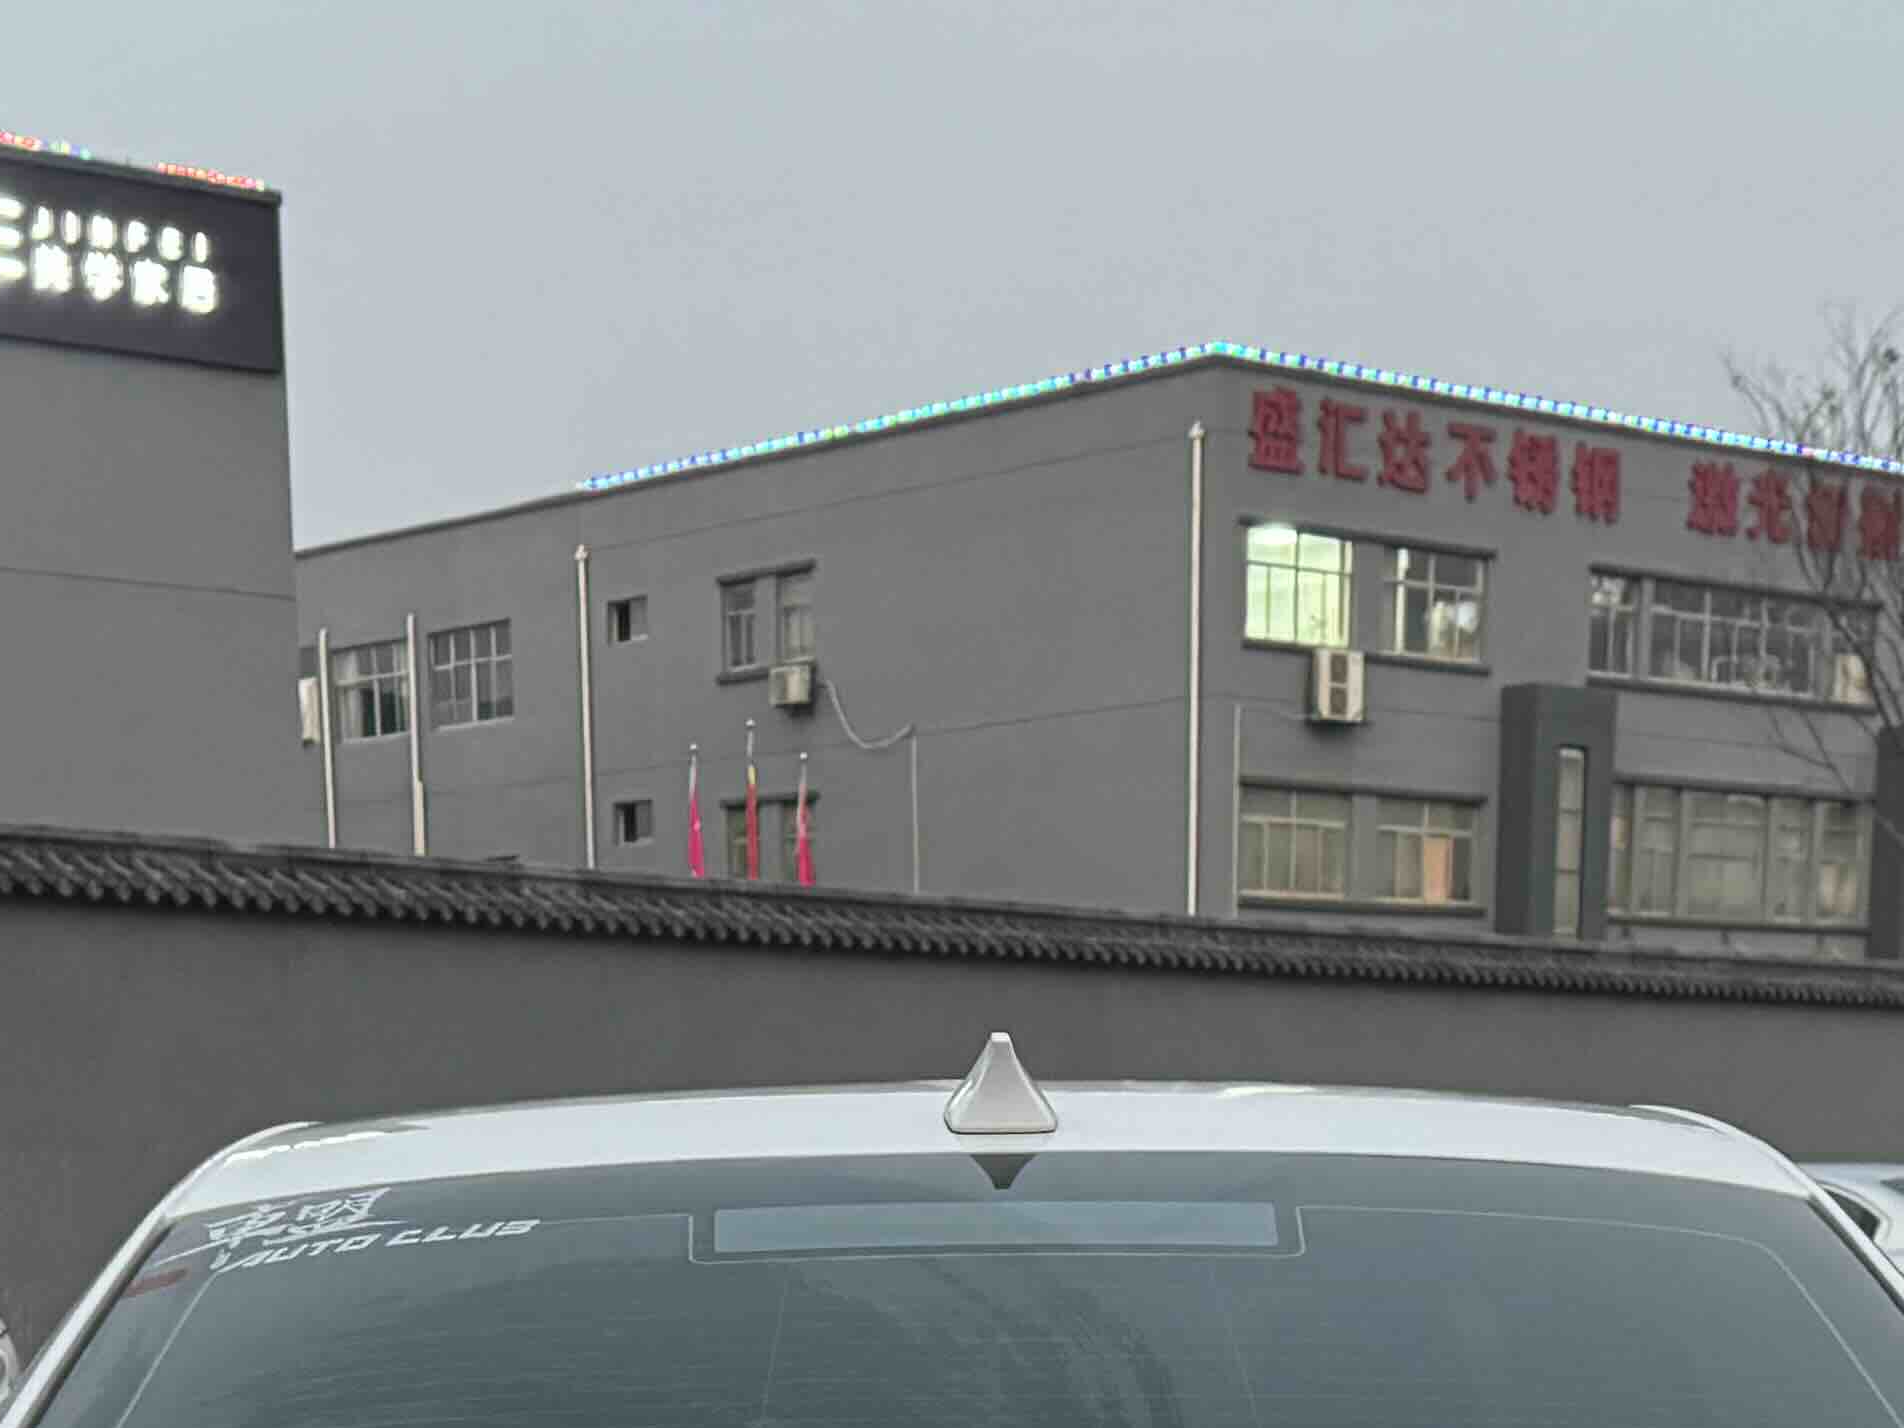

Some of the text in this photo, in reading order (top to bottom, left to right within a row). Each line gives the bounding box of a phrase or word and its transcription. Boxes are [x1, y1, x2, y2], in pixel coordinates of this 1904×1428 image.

[1247, 386, 1623, 524] 盛汇达不锈钢
[217, 1219, 540, 1274] AUTO CLUB
